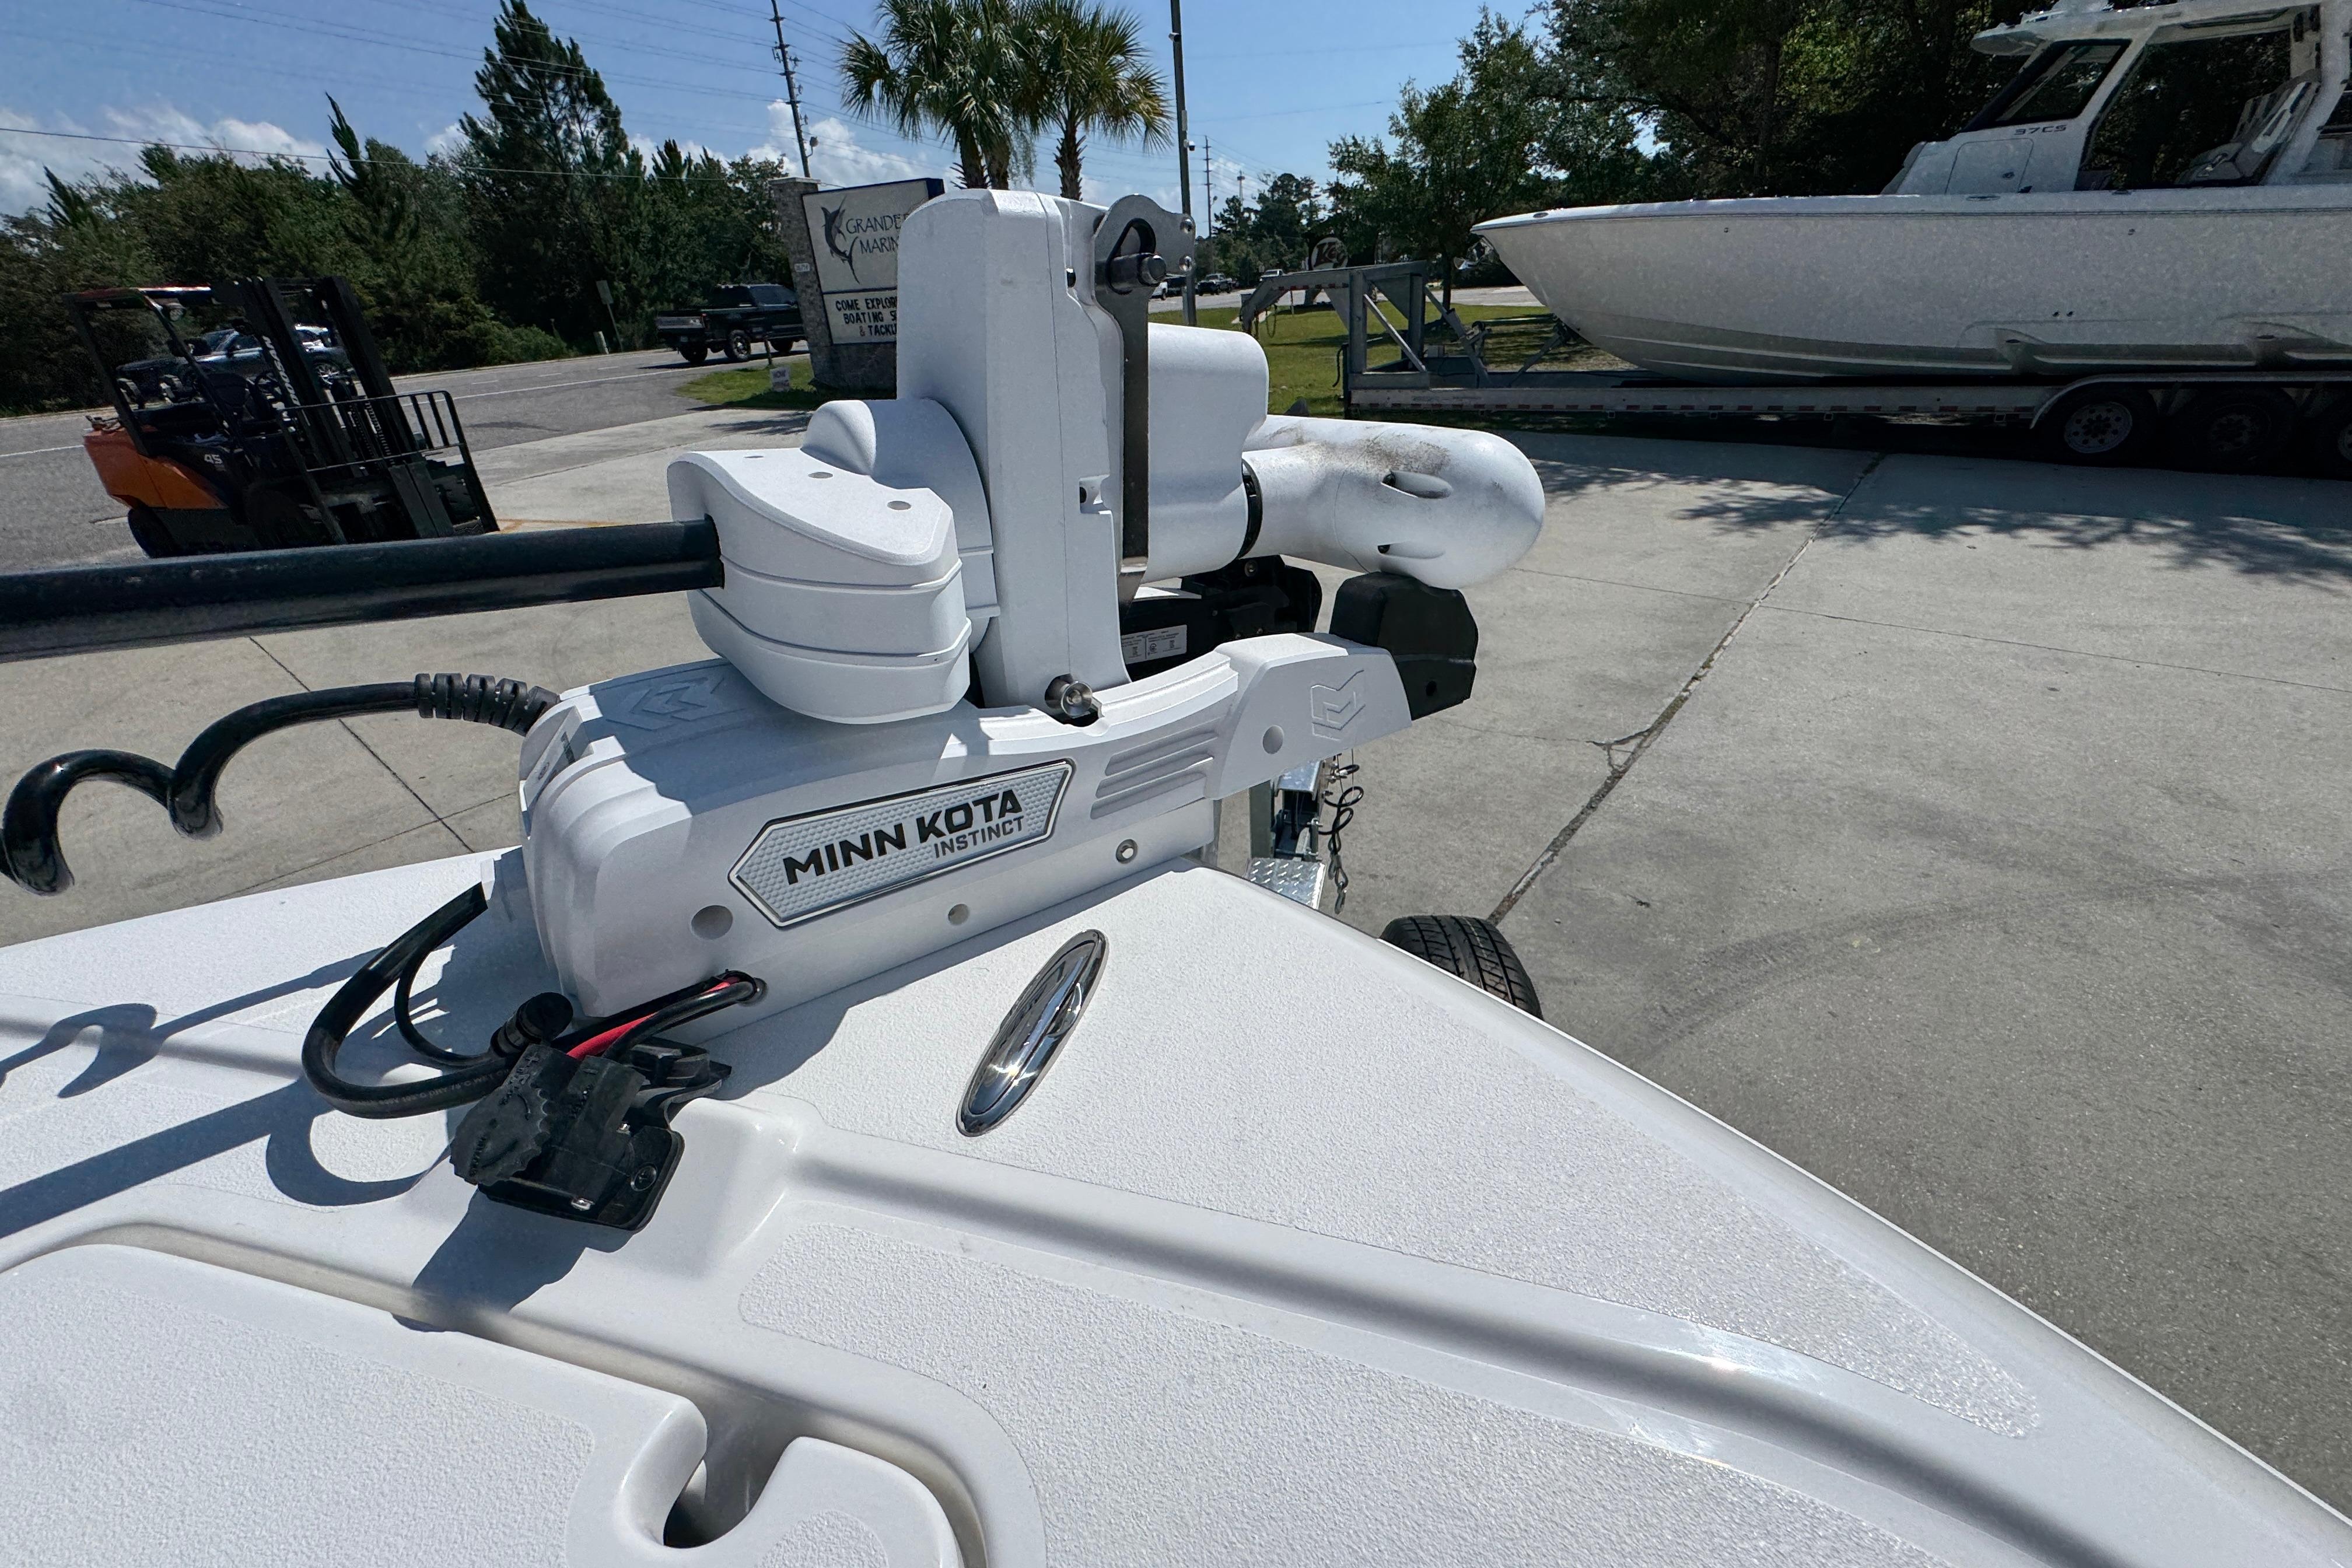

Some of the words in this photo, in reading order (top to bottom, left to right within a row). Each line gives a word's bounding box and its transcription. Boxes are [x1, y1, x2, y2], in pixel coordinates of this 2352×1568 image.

[2014, 124, 2067, 135] 37CS
[835, 298, 860, 311] COME
[843, 311, 884, 324] BOATING
[859, 326, 866, 337] &
[262, 335, 301, 406] DOOSAN
[782, 822, 907, 885] MINN
[916, 789, 1023, 844] KOTA
[934, 817, 1024, 859] INSTINCT
